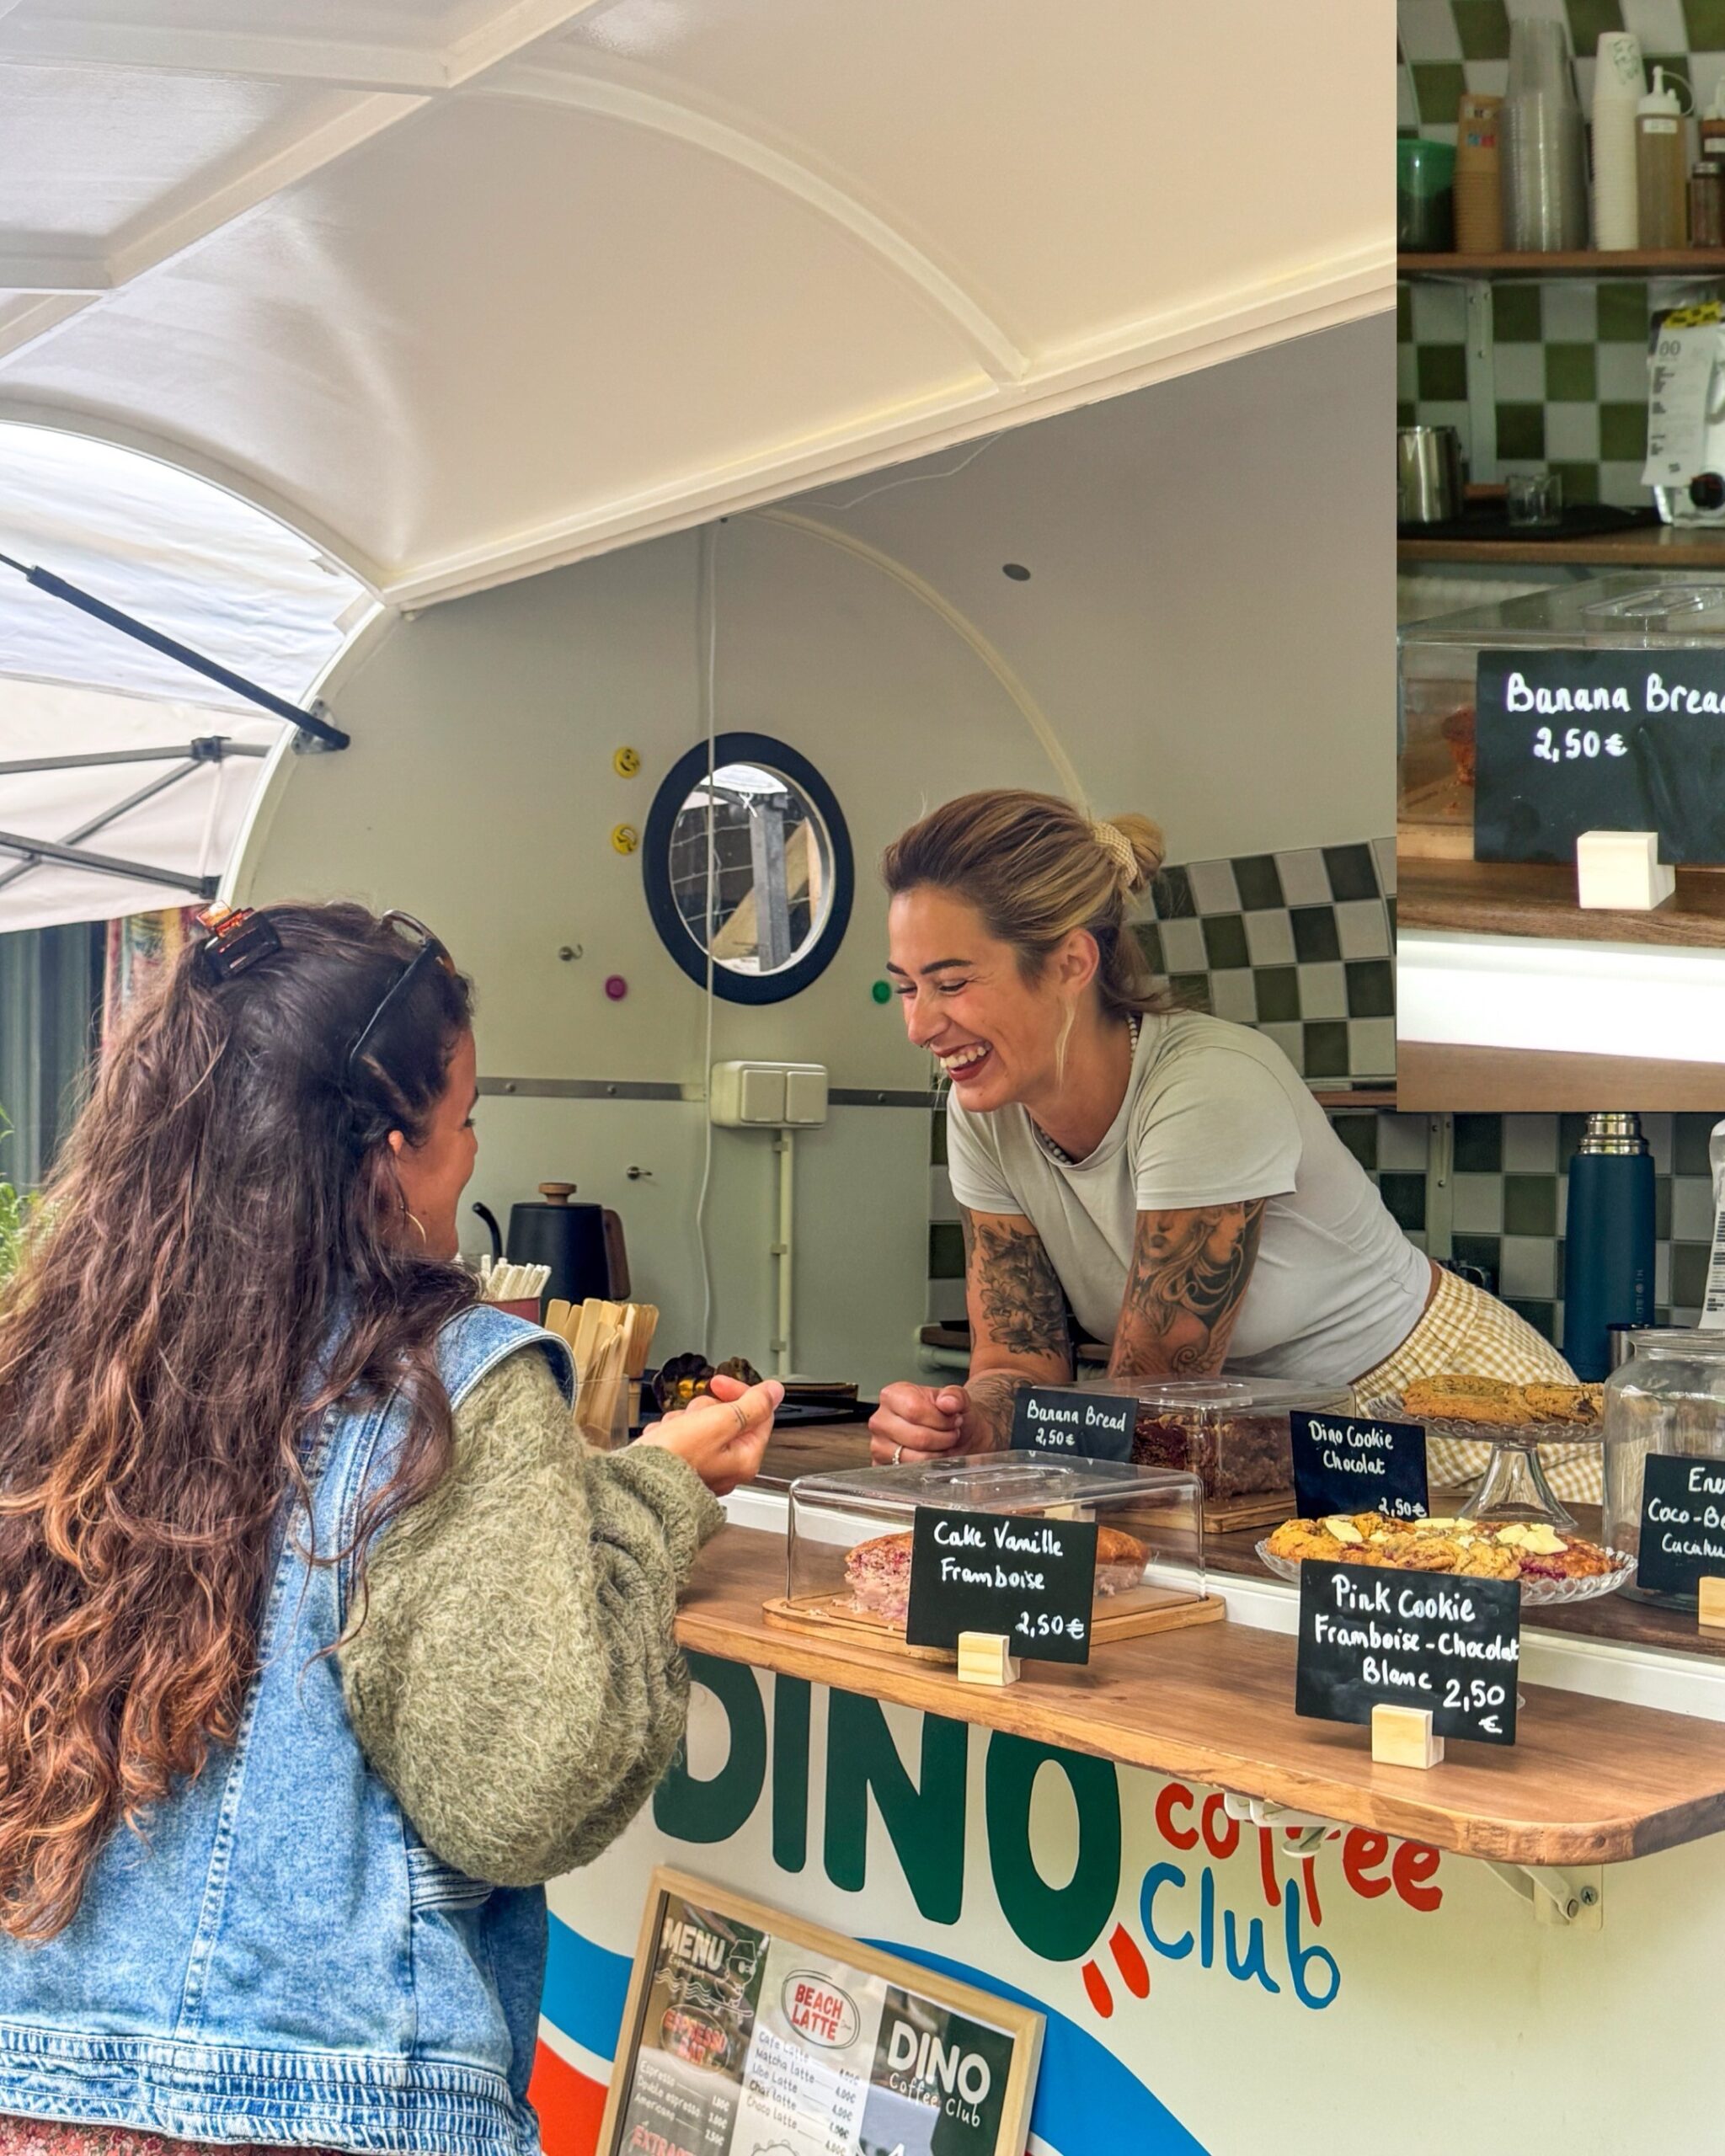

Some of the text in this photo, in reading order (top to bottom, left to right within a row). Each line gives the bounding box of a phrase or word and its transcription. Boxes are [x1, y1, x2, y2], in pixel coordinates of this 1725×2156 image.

[1507, 672, 1632, 714] Banana
[1533, 726, 1628, 763] 2,50€
[1027, 1399, 1127, 1433] Banana Bread
[1034, 1428, 1076, 1447] 2,50€
[1308, 1420, 1394, 1450] Dino Cookie
[1323, 1449, 1386, 1475] Chocolat
[1378, 1497, 1428, 1518] 2,50€
[933, 1520, 1064, 1557] Cake Vanille
[941, 1556, 1045, 1590] Framboise
[1331, 1573, 1476, 1622] Pink Cookie
[1015, 1610, 1085, 1641] 2,50€
[1362, 1655, 1506, 1712] Blanc 2,50
[653, 1646, 1123, 1961] DINO
[661, 1918, 726, 1971] MENU
[1139, 1861, 1341, 2010] Club
[794, 1983, 843, 2020] BEACH
[791, 2004, 838, 2041] LATTE
[638, 2060, 676, 2088] Espresso
[755, 2047, 788, 2071] Matcha
[887, 2020, 991, 2105] DINO
[772, 2073, 798, 2095] Latte
[889, 2072, 981, 2128] Coffee Club
[631, 2124, 697, 2156] EXTRA
